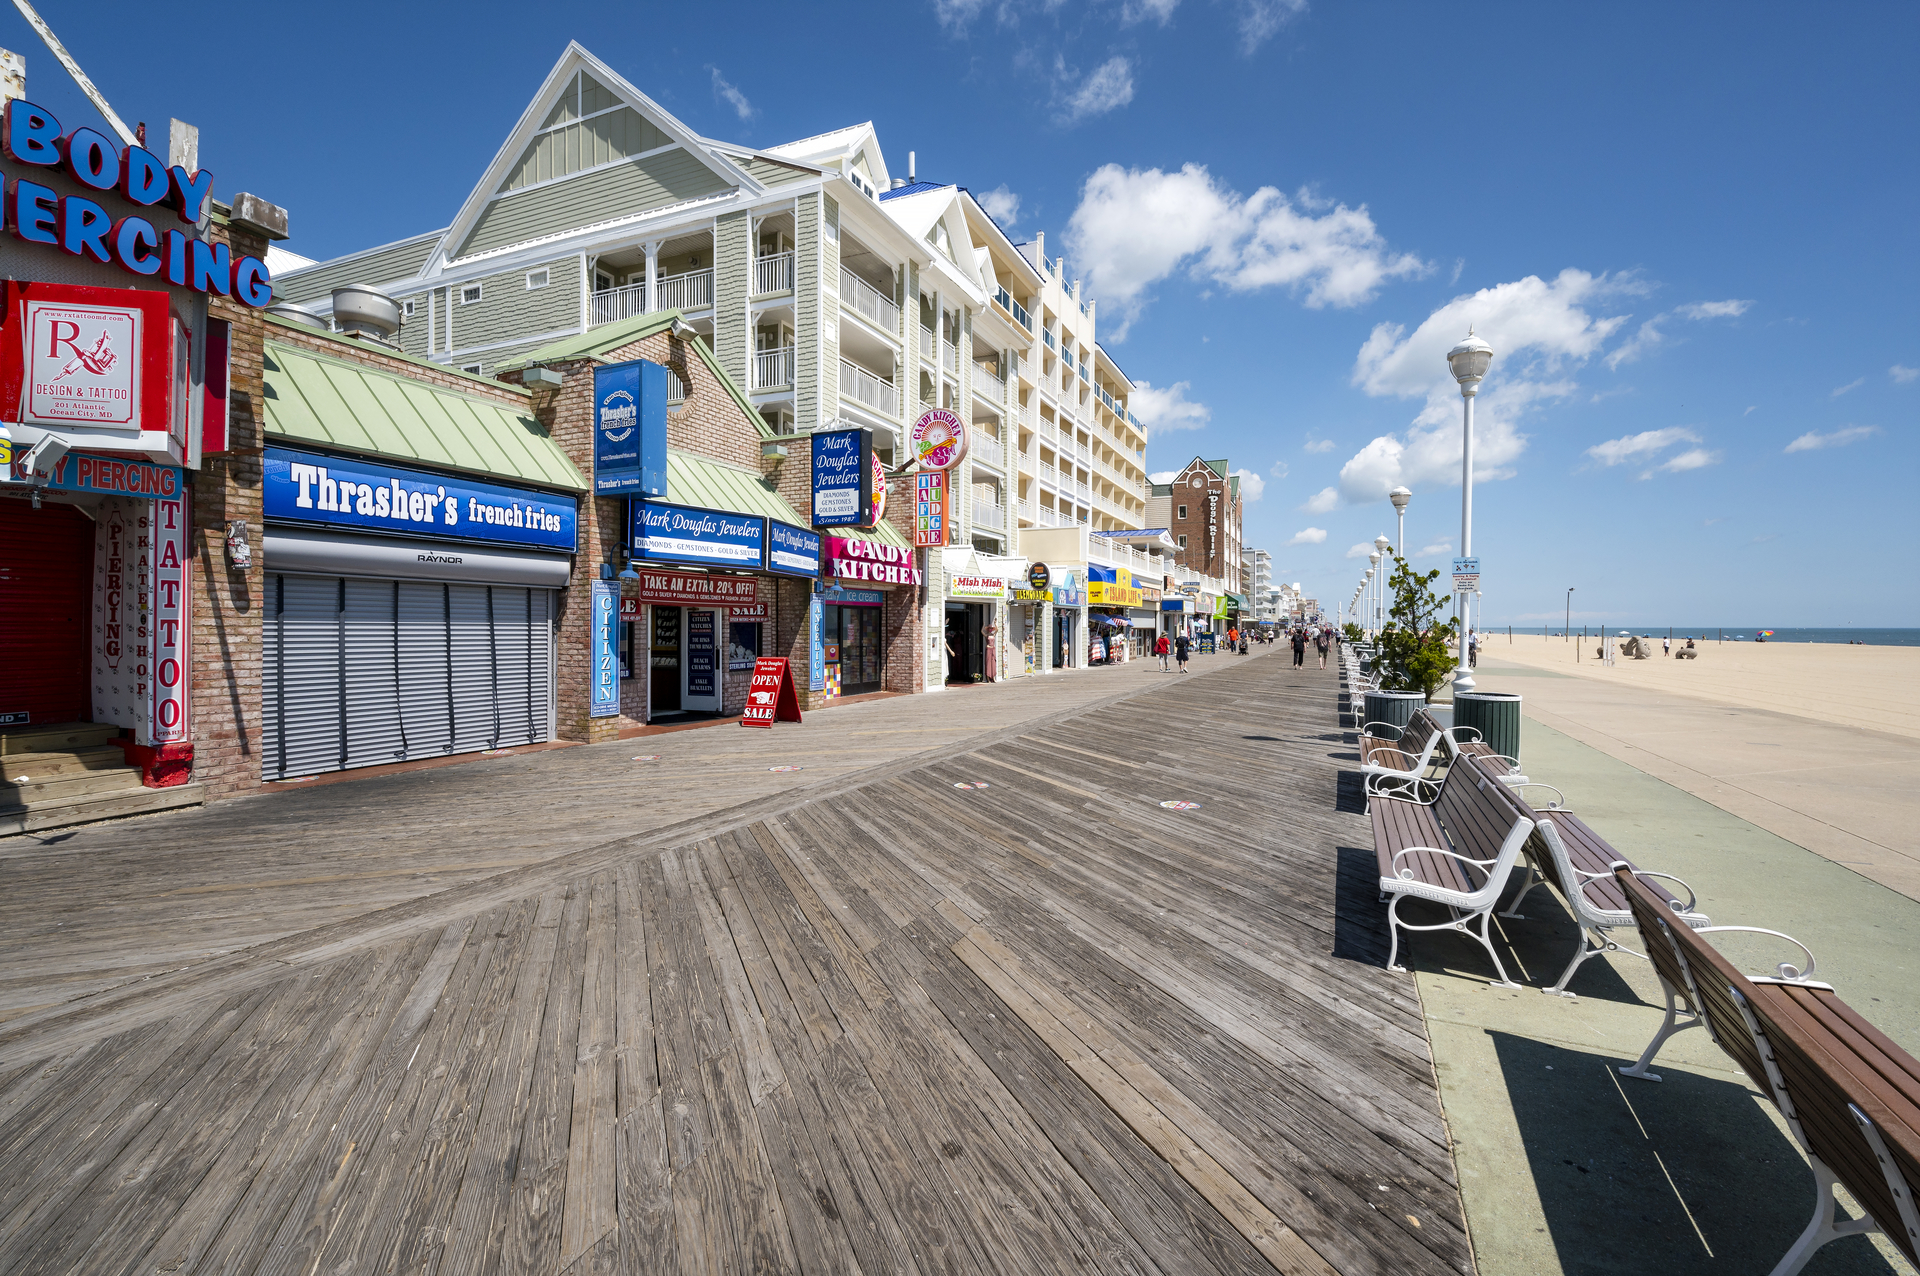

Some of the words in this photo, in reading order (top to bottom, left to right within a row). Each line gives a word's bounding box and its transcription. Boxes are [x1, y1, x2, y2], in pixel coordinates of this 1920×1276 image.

[5, 98, 213, 225] BODY
[0, 170, 273, 308] ERCING
[44, 311, 123, 322] www.rxtattoomd.com
[36, 383, 73, 396] DESIGN
[76, 387, 84, 397] &
[88, 387, 127, 400] TATTOO
[50, 408, 75, 416] Ocean
[72, 403, 105, 411] Atlantic
[600, 403, 637, 421] Thrasher's
[601, 418, 621, 431] french
[621, 416, 637, 428] fries
[913, 413, 931, 440] CANDY
[933, 411, 961, 437] KITCHEN
[822, 432, 853, 451] Mark
[816, 451, 859, 471] Douglas
[77, 456, 175, 497] PIERCING
[598, 479, 621, 489] Thrasher's
[815, 469, 859, 488] Jewelers
[291, 462, 458, 526] Thrasher's
[468, 496, 524, 528] french
[525, 504, 561, 533] fries
[823, 491, 850, 499] DIAMONDS
[918, 474, 929, 544] TAFFY
[930, 474, 941, 544] FUDGE
[1208, 495, 1218, 524] Dough
[636, 509, 671, 533] Mark
[672, 513, 717, 537] Douglas
[716, 519, 760, 538] Jewelers
[818, 517, 839, 525] Since
[637, 538, 673, 549] DIAMONDS
[676, 543, 714, 553] GEMSTONES
[717, 547, 734, 556] GOLD
[739, 549, 759, 557] SILVER
[772, 527, 786, 547] Mark
[786, 531, 803, 551] Douglas
[802, 536, 819, 552] Jewelers
[1208, 525, 1217, 558] Roller
[137, 516, 149, 605] SKATE
[417, 554, 463, 564] RAYNOR
[846, 538, 912, 565] CANDY
[832, 558, 923, 586] KITCHEN
[957, 577, 979, 586] Mish
[981, 578, 1002, 587] Mish
[106, 525, 122, 657] PIERCING
[643, 575, 668, 590] TAKE
[670, 577, 684, 592] AN
[686, 578, 714, 593] EXTRA
[716, 580, 733, 594] 20%
[736, 582, 755, 595] OFF!!
[846, 588, 855, 601] ice
[858, 592, 879, 602] cream
[1110, 586, 1126, 602] ISLAND
[1128, 590, 1138, 603] LIFE
[158, 500, 181, 729] TATTOO
[600, 597, 613, 700] CITIZEN
[136, 625, 148, 695] SHOP
[729, 662, 747, 670] STERLING
[752, 675, 780, 686] OPEN
[743, 707, 774, 719] SALE
